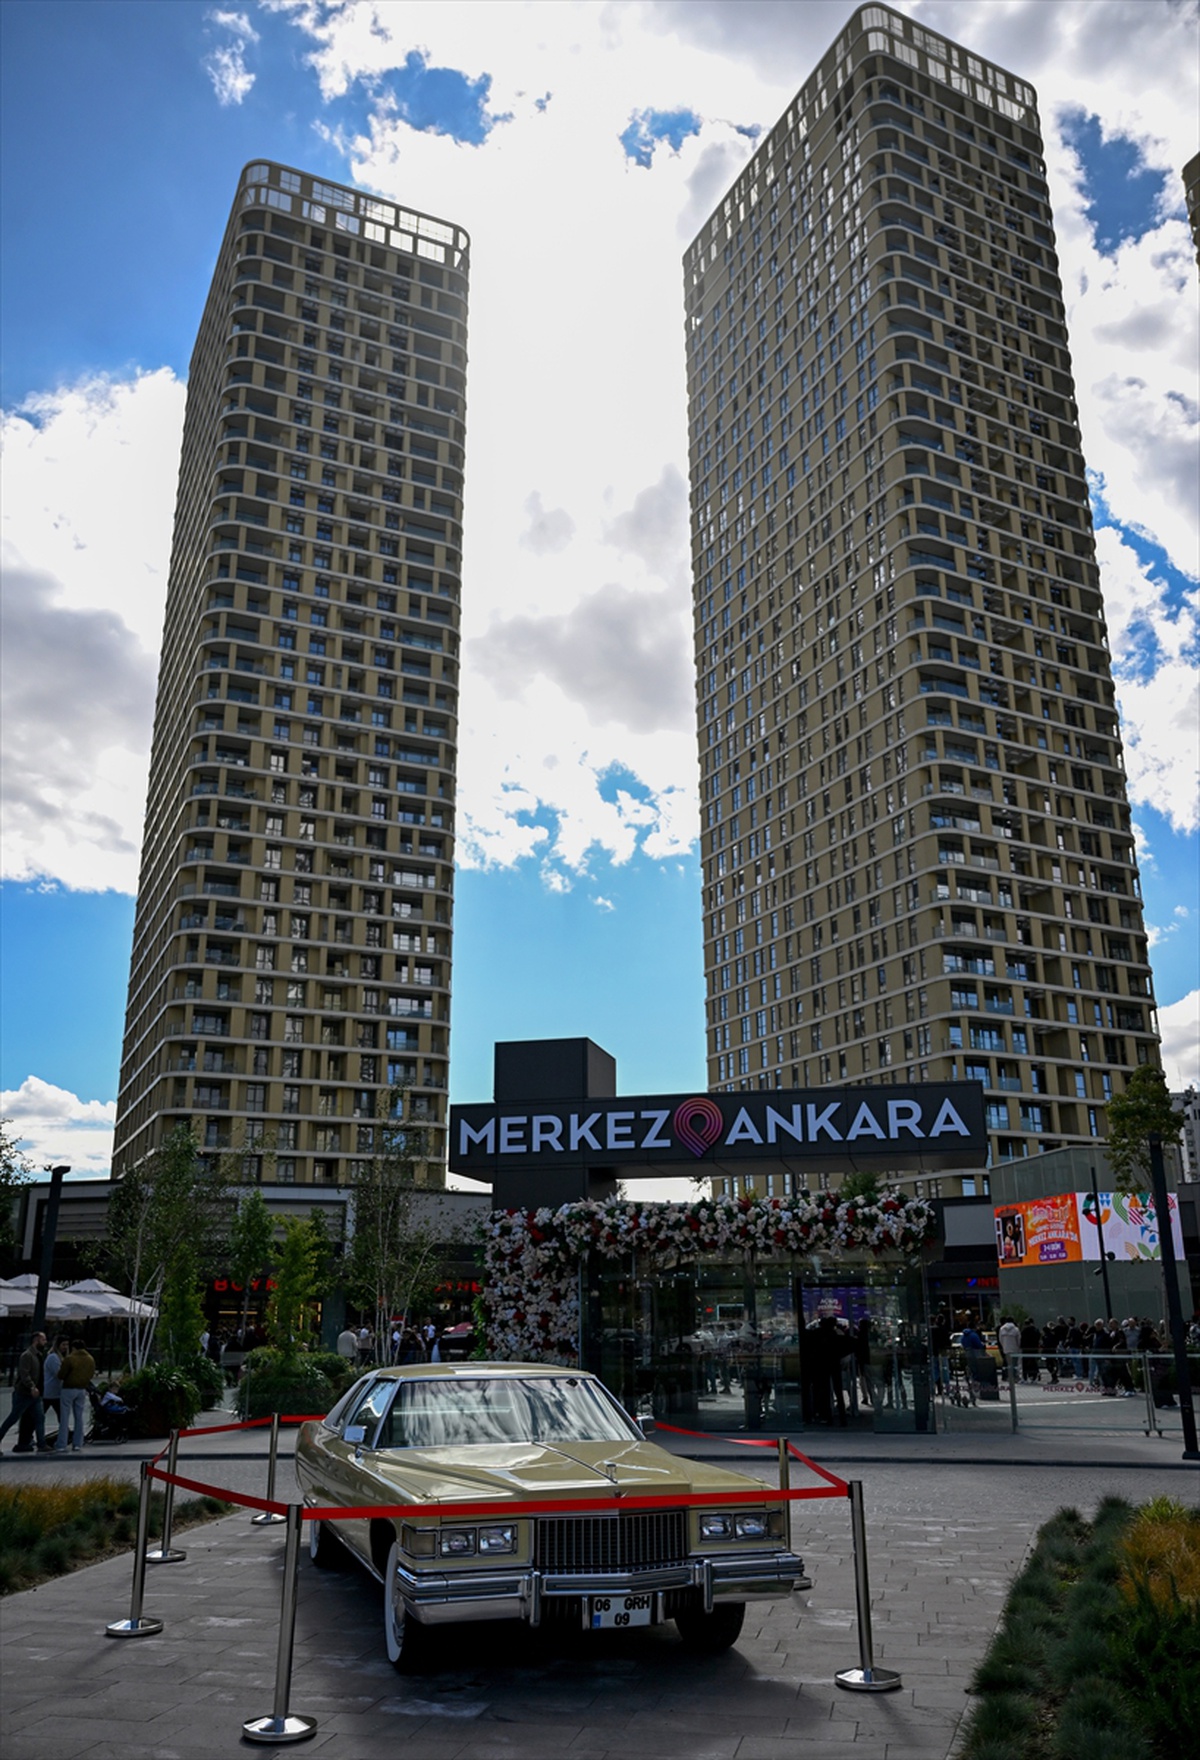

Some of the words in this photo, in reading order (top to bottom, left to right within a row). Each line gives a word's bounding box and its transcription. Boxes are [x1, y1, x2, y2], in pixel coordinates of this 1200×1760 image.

[459, 1109, 671, 1155] MERKEZ
[724, 1098, 971, 1145] ANKARA
[213, 1278, 278, 1292] BOYN
[595, 1599, 611, 1612] 06
[624, 1595, 650, 1610] GRH
[614, 1612, 630, 1626] 09
